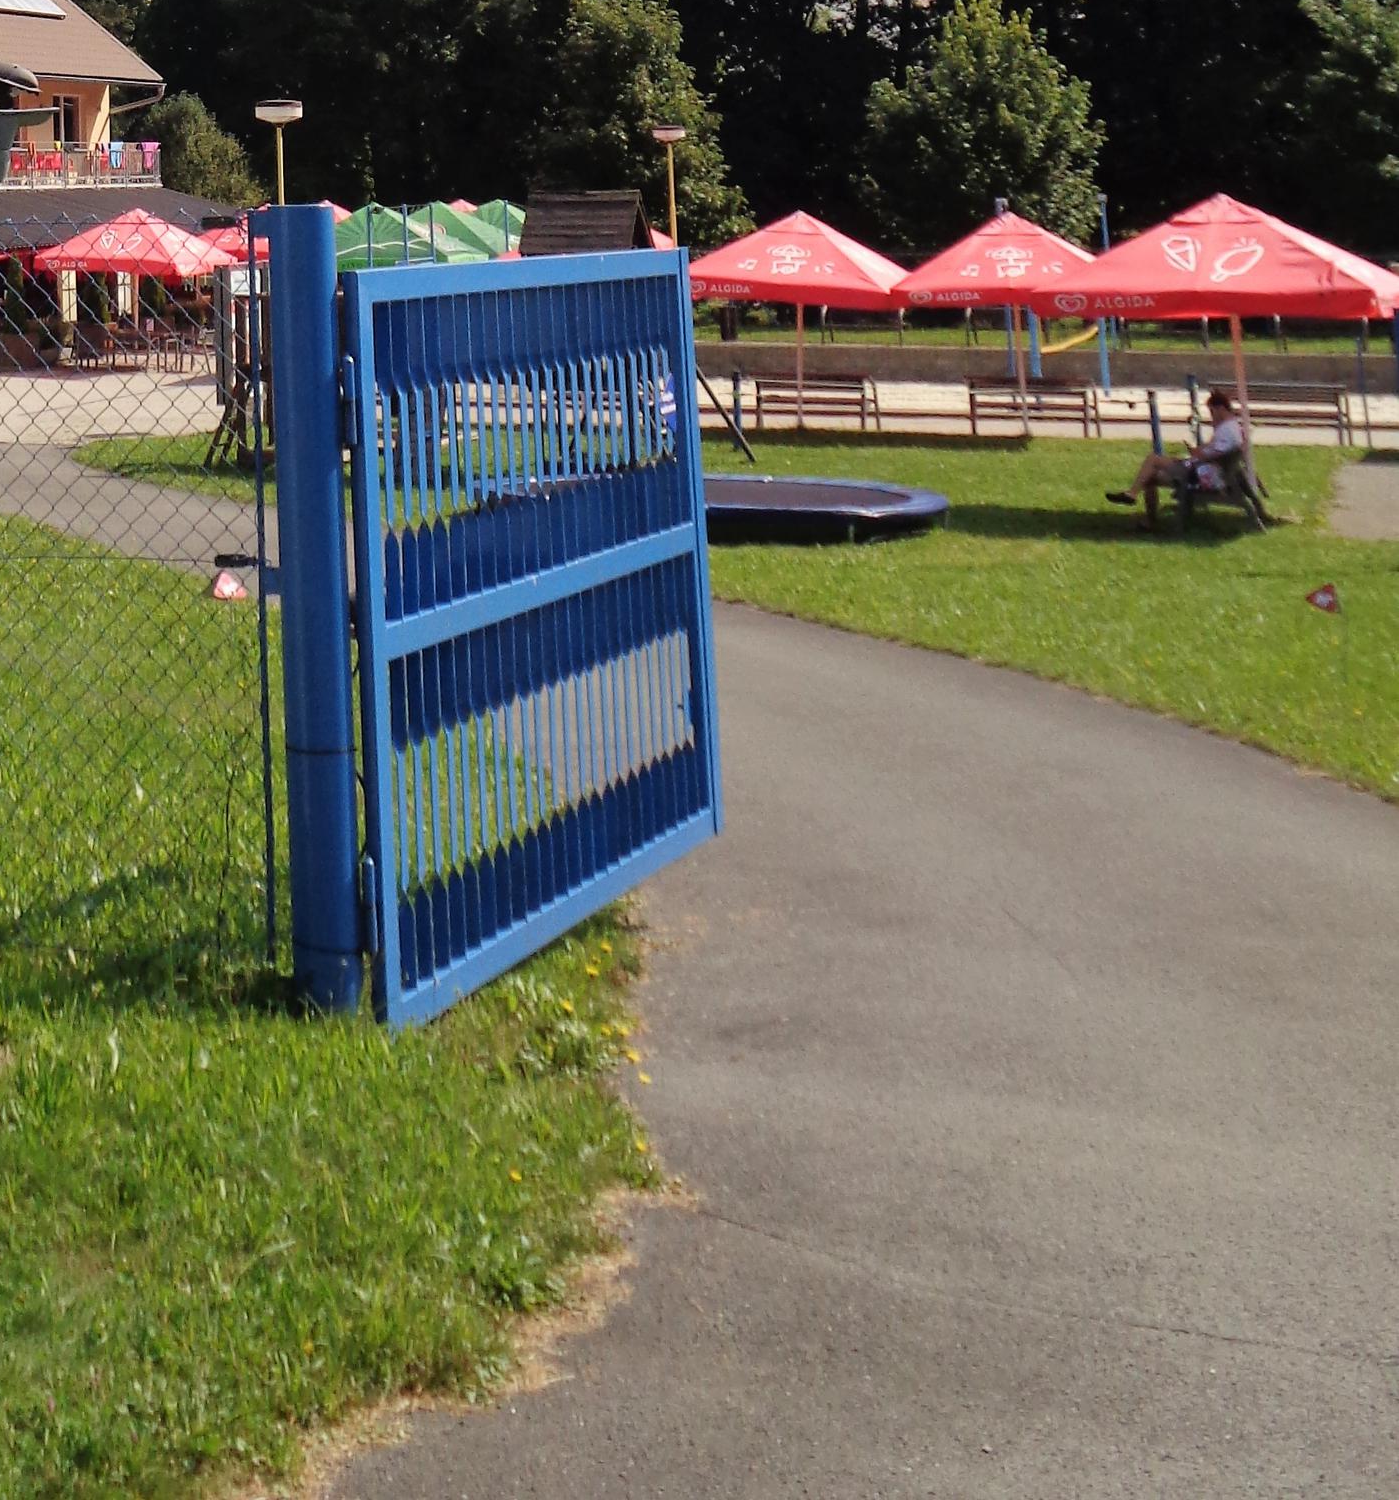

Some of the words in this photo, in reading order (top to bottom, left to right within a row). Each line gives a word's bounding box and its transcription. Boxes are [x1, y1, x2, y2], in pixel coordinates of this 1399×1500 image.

[710, 283, 750, 294] ALGIDA
[936, 291, 980, 301] ALGIDA
[1094, 295, 1155, 308] ALGIDA
